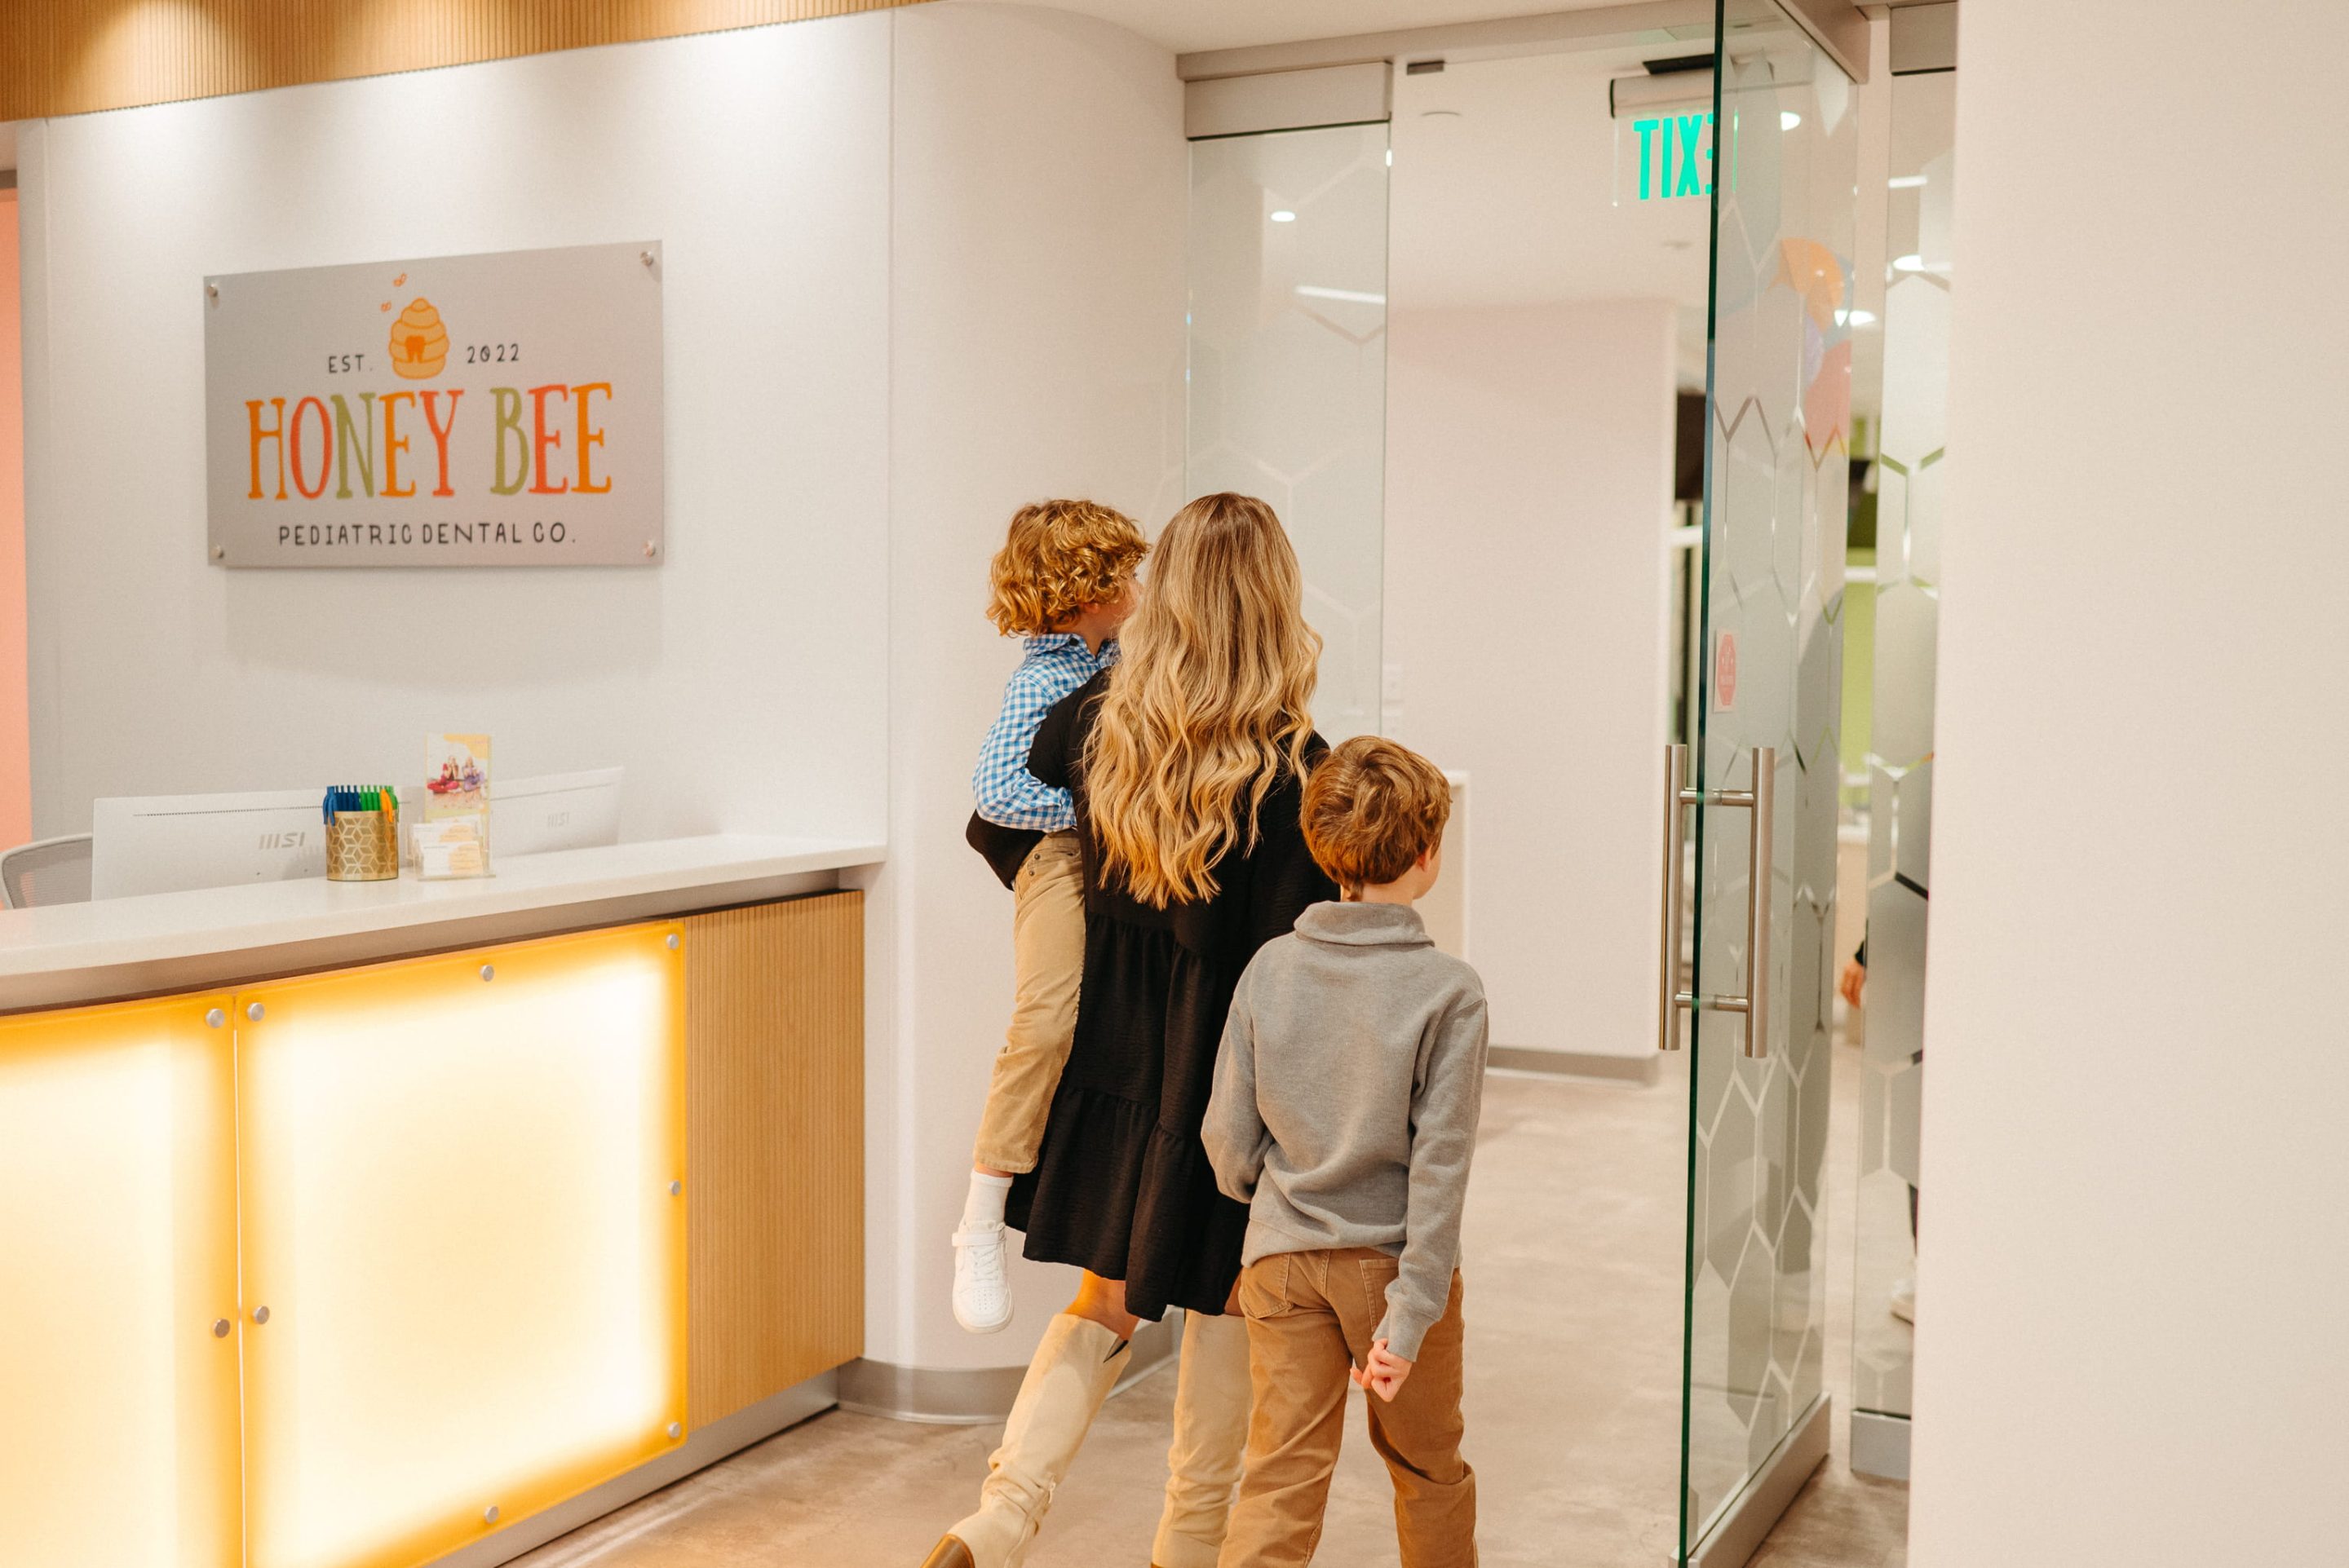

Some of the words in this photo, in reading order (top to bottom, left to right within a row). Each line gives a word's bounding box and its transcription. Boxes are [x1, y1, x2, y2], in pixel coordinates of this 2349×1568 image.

[328, 354, 374, 373] EST.
[467, 343, 520, 364] 2022
[246, 389, 465, 501] HONEY
[489, 382, 613, 496] BEE
[279, 523, 413, 545] PEDIATRIC
[422, 523, 523, 544] DENTAL
[533, 522, 577, 544] CO.
